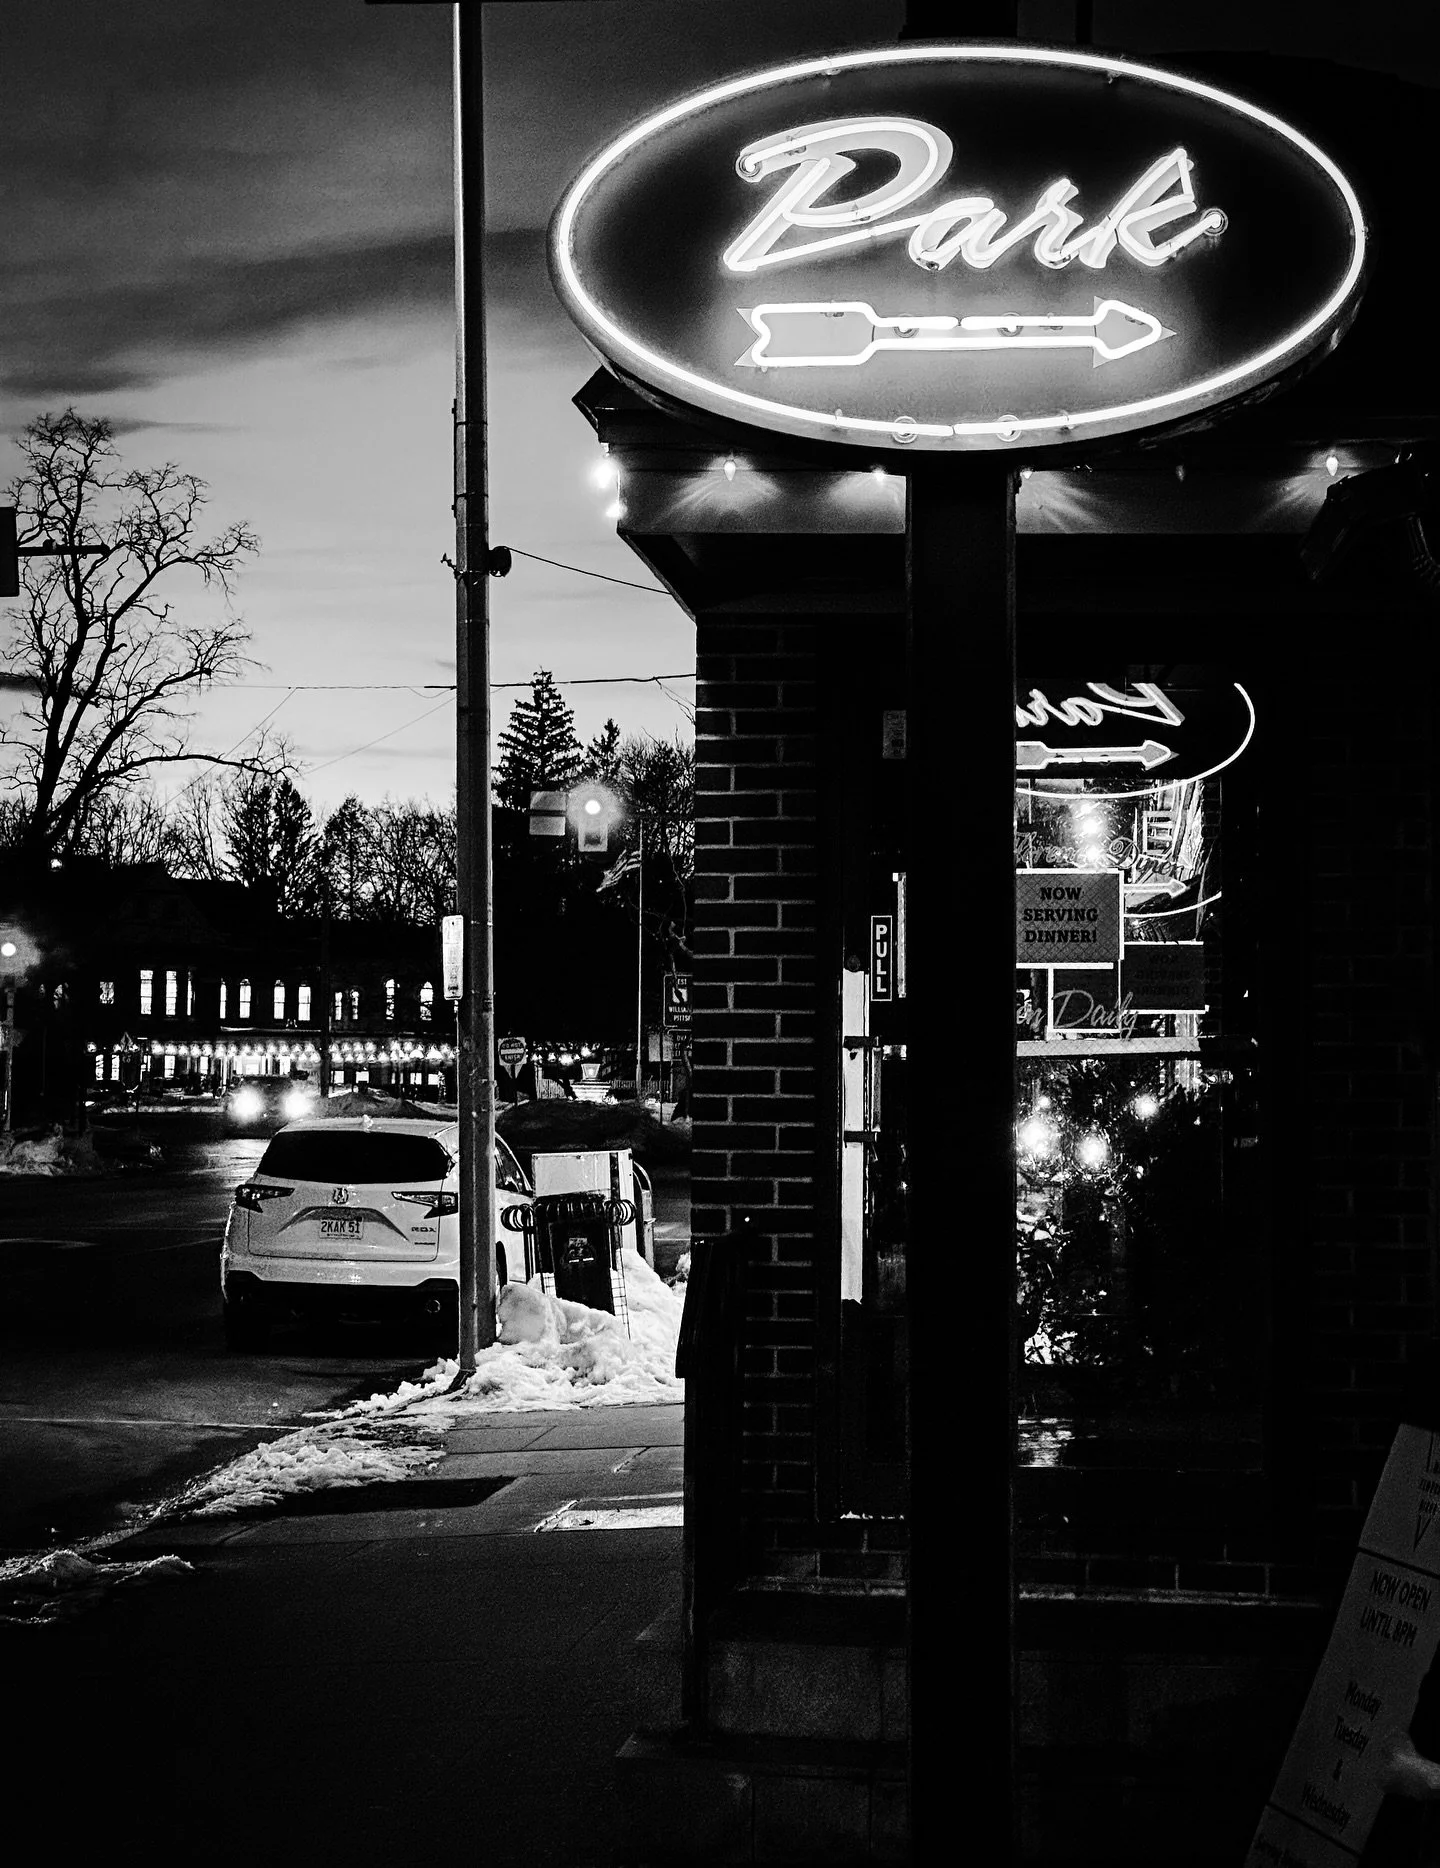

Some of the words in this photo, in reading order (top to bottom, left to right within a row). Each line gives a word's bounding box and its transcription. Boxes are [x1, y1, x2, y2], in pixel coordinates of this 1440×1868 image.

[724, 115, 1229, 272] Park
[1040, 887, 1082, 900] NOW
[1023, 908, 1099, 922] SERVING
[1025, 929, 1097, 943] DINNER!
[875, 924, 888, 993] PULL
[1051, 988, 1138, 1039] Daily
[321, 1220, 346, 1233] 2KAK
[348, 1220, 360, 1234] 51
[1369, 1571, 1401, 1600] NOW
[1399, 1581, 1432, 1613] OPEN
[1360, 1606, 1394, 1639] UNTIL
[1344, 1681, 1383, 1721] Monday
[1333, 1715, 1369, 1757] Tuesday
[1301, 1783, 1352, 1834] Wednesday
